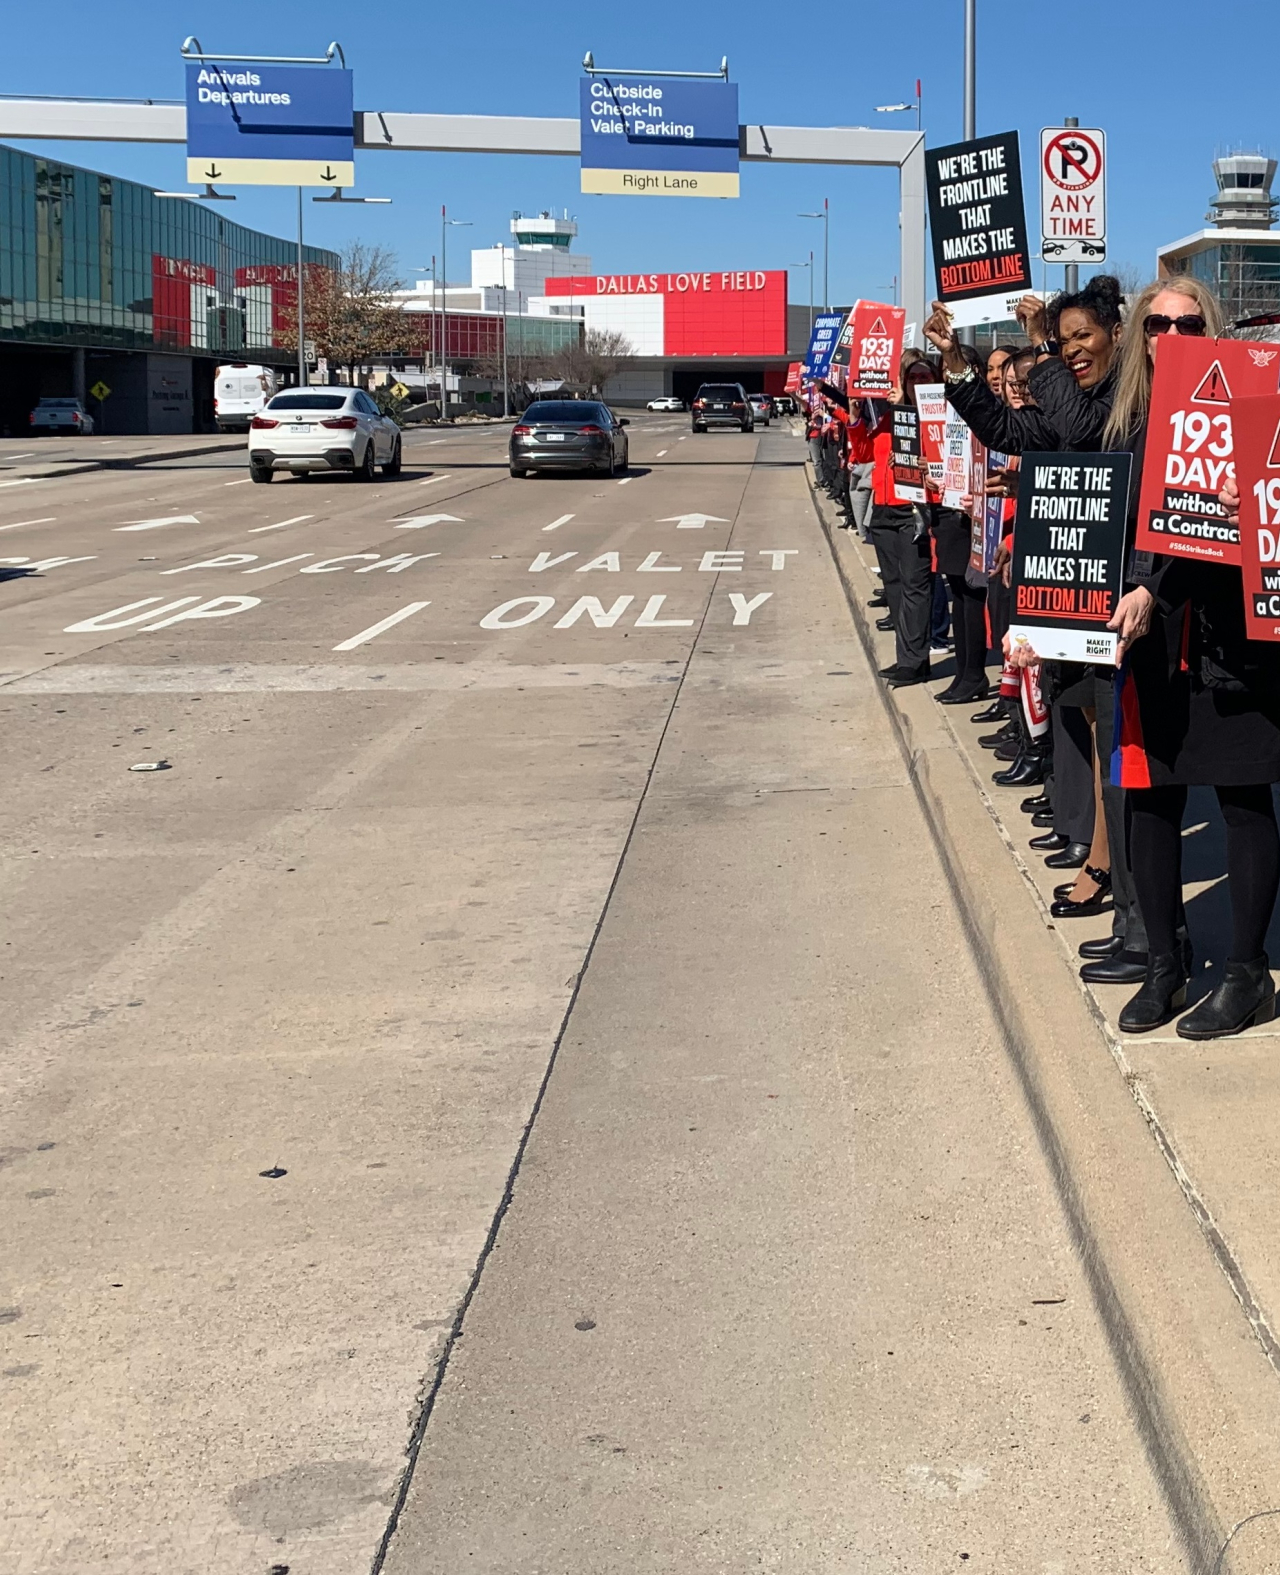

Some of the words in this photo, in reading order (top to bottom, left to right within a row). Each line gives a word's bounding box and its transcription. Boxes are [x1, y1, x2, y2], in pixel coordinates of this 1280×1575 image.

[197, 69, 261, 86] Arrivals
[198, 87, 291, 106] Departures
[590, 82, 662, 99] Curbside
[590, 101, 662, 117] Check-In
[590, 119, 630, 134] Valet
[634, 120, 694, 139] Parking
[937, 151, 978, 181] WE'RE
[979, 146, 1006, 171] THE
[623, 174, 659, 190] Right
[664, 176, 698, 188] Lane
[939, 173, 1009, 207] FRONTLINE
[1050, 194, 1095, 213] ANY
[959, 204, 992, 230] THAT
[1049, 217, 1096, 236] TIME
[942, 232, 987, 261] MAKES
[988, 227, 1016, 252] THE
[940, 260, 992, 288] BOTTOM
[993, 253, 1024, 278] LINE
[596, 275, 658, 294] DALLAS
[667, 273, 711, 292] LOVE
[721, 271, 766, 290] FIELD
[860, 338, 894, 356] 1931
[859, 356, 891, 369] DAYS
[860, 371, 888, 379] without
[860, 380, 892, 389] Contract
[927, 424, 940, 442] SO
[1169, 410, 1234, 458] 193
[1034, 465, 1081, 491] WE'RE
[1083, 467, 1113, 491] THE
[1030, 495, 1111, 522] FRONTLINE
[1167, 493, 1226, 517] withou
[1049, 526, 1087, 551] THAT
[1152, 518, 1164, 532] a
[1167, 516, 1241, 542] Contrac
[1169, 542, 1224, 558] #556StrikesBack
[160, 552, 442, 575] PICK
[527, 549, 799, 572] VALET
[1024, 555, 1075, 582] MAKES
[1078, 558, 1108, 583] THE
[1016, 585, 1075, 612] BOTTOM
[1078, 589, 1113, 614] LINE
[1256, 603, 1267, 616] a
[62, 595, 262, 633] UP
[479, 592, 774, 629] ONLY
[1086, 638, 1104, 646] MAKE
[1086, 646, 1111, 655] RIGHT!
